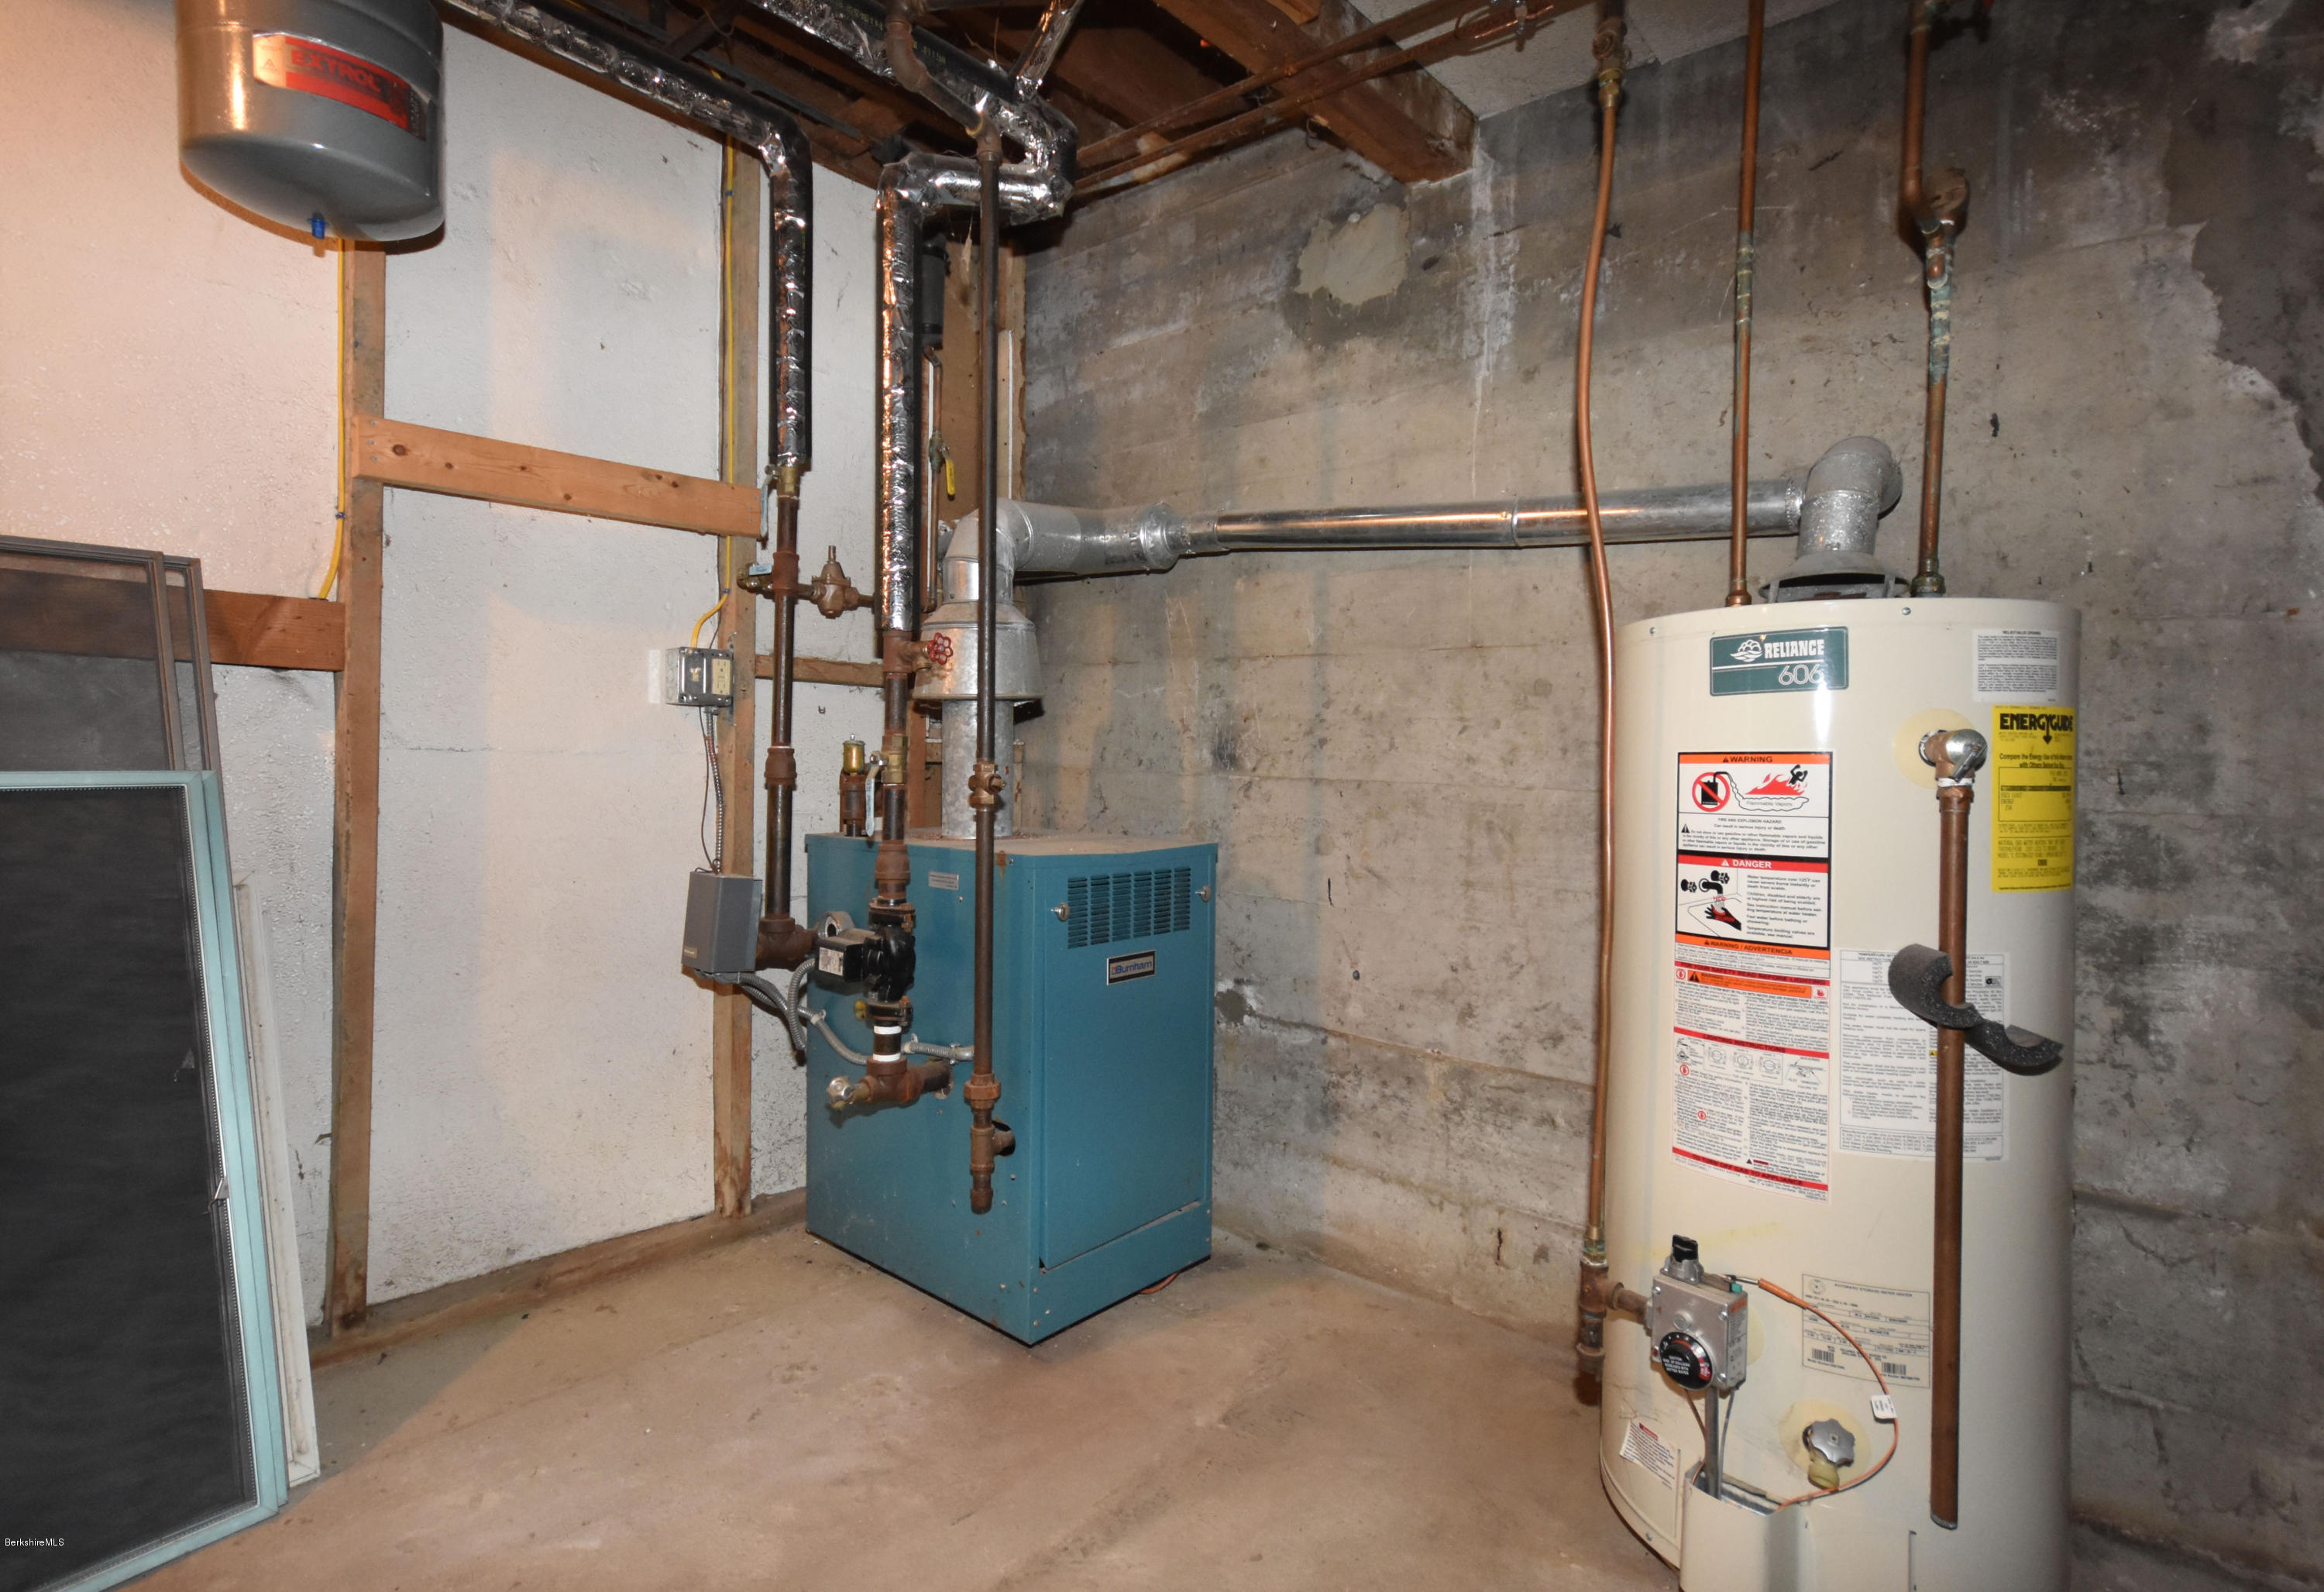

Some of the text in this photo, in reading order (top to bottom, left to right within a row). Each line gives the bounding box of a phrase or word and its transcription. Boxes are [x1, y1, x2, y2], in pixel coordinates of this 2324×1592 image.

[291, 49, 381, 92] EXTROL
[1764, 639, 1824, 658] RELIANCE
[1779, 664, 1824, 685] 606
[1733, 859, 1772, 868] DANGER
[1744, 945, 1793, 954] ADVERTENCIA
[1116, 960, 1152, 975] Burnham
